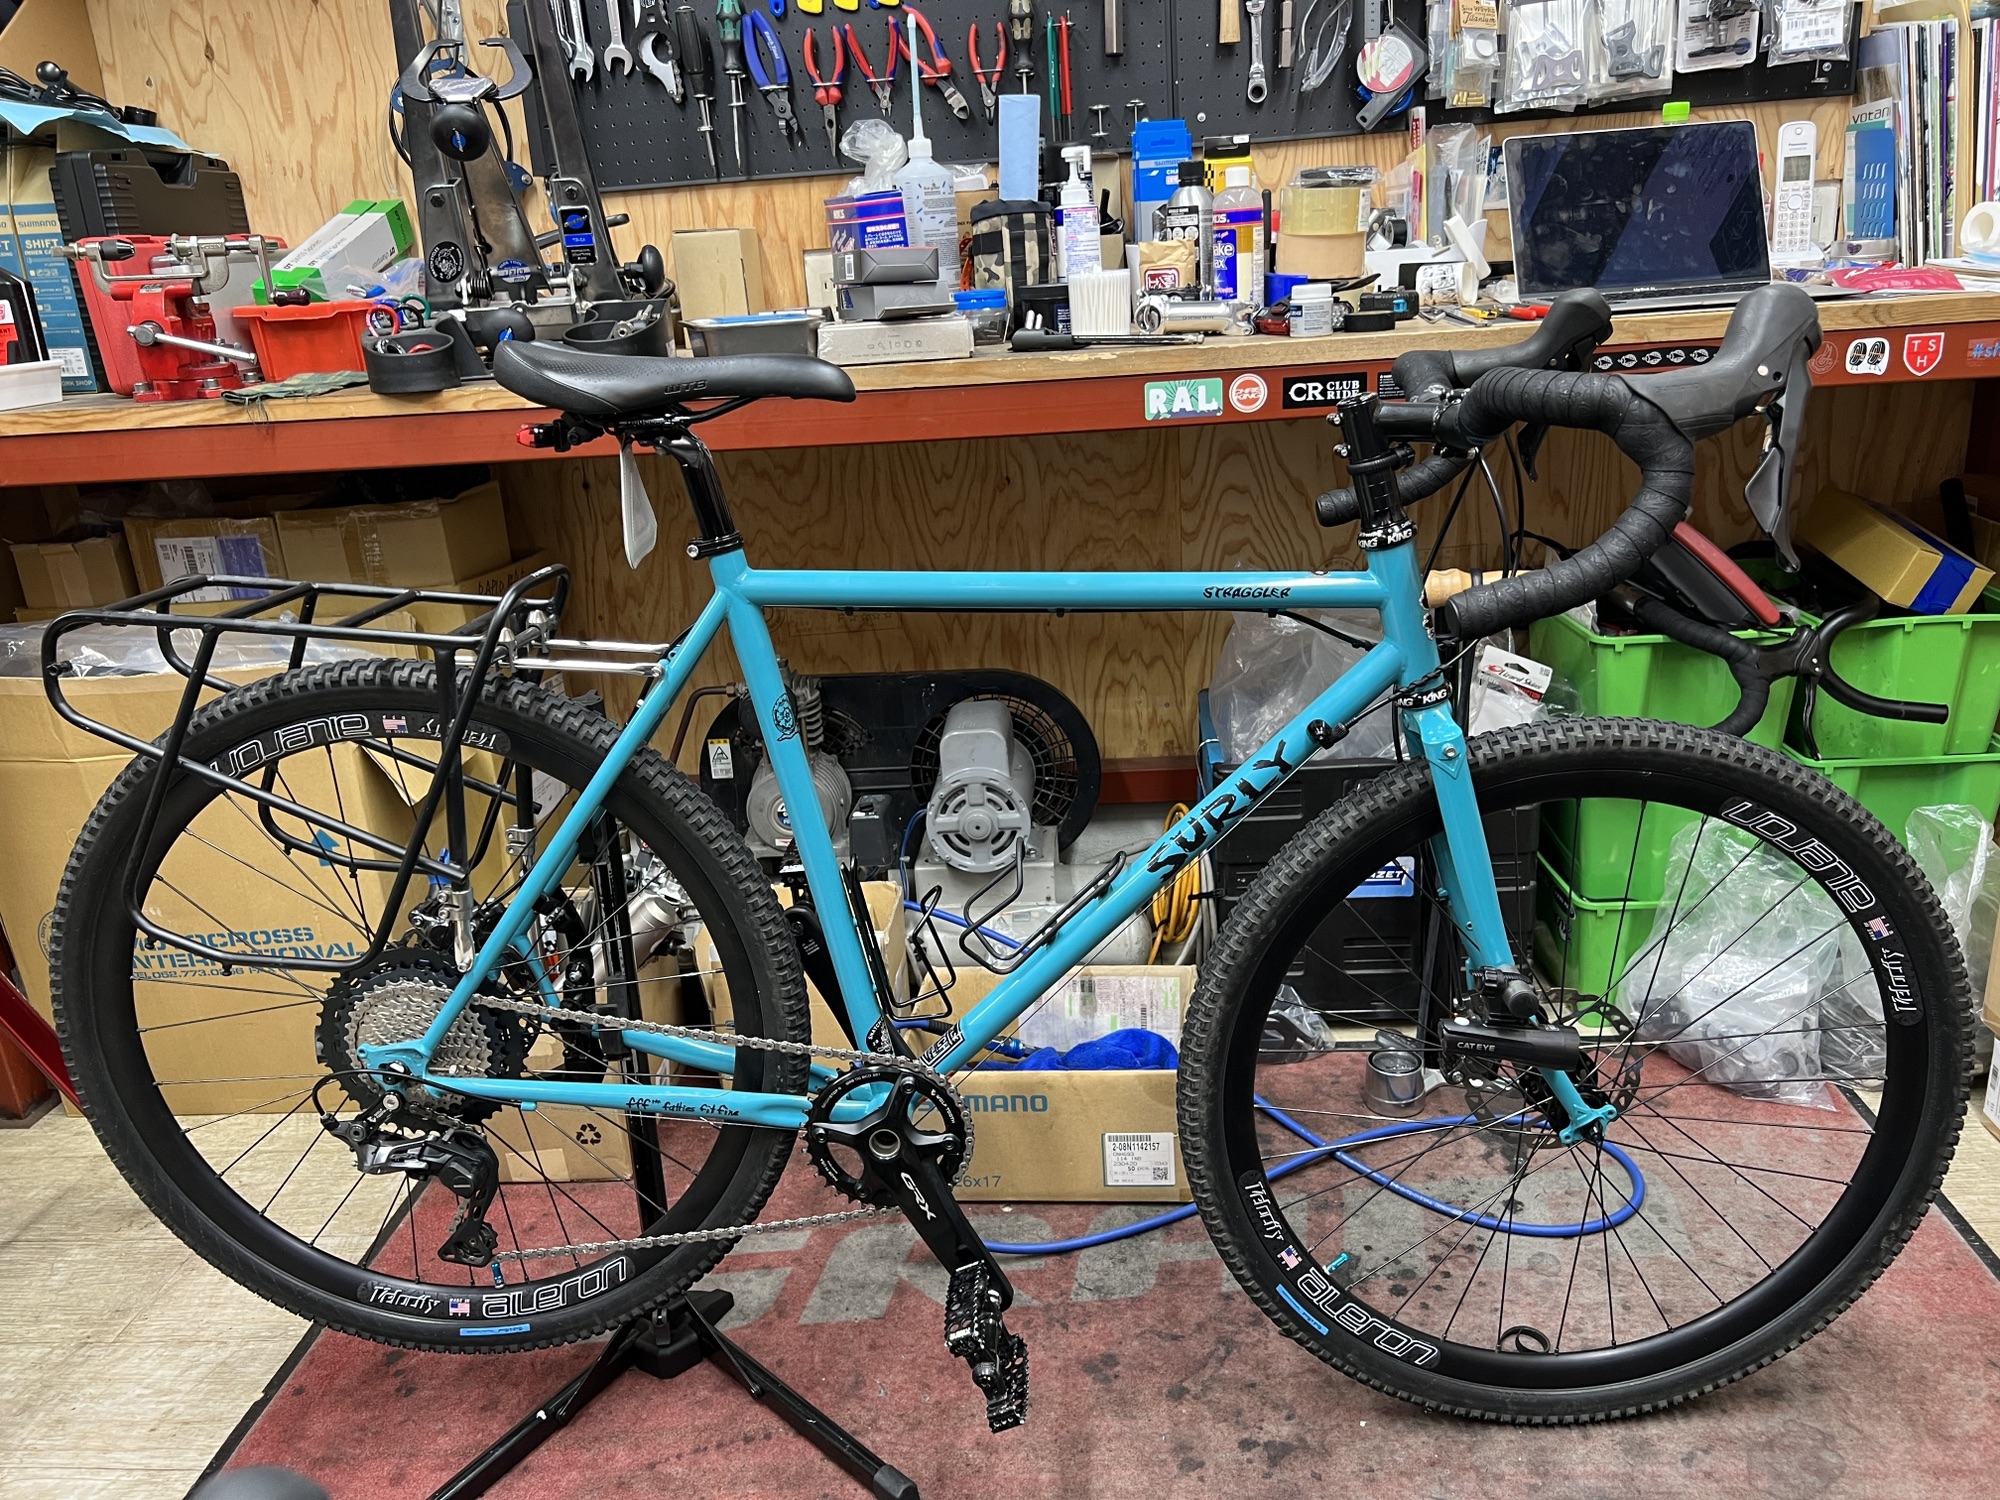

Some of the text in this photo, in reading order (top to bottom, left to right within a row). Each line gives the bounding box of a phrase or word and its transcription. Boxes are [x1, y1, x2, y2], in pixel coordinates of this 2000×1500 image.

[18, 220, 57, 229] SHIMANO
[25, 239, 59, 249] SHIFT
[1149, 383, 1218, 415] RAL
[1288, 381, 1360, 402] CR CLUB
[1327, 389, 1359, 400] RIDE
[1388, 529, 1412, 544] KING
[1203, 586, 1293, 600] STRAGGLER
[1423, 687, 1448, 704] KING
[1147, 739, 1293, 884] SURLY
[1721, 801, 1876, 914] aileron
[662, 1102, 695, 1112] fatties
[699, 1103, 717, 1114] fit
[1112, 1142, 1160, 1151] 2-08N1142157
[900, 1171, 937, 1221] GRX
[482, 1256, 627, 1319] aileron
[368, 1284, 441, 1315] Velocity
[1296, 1266, 1439, 1366] aileron
